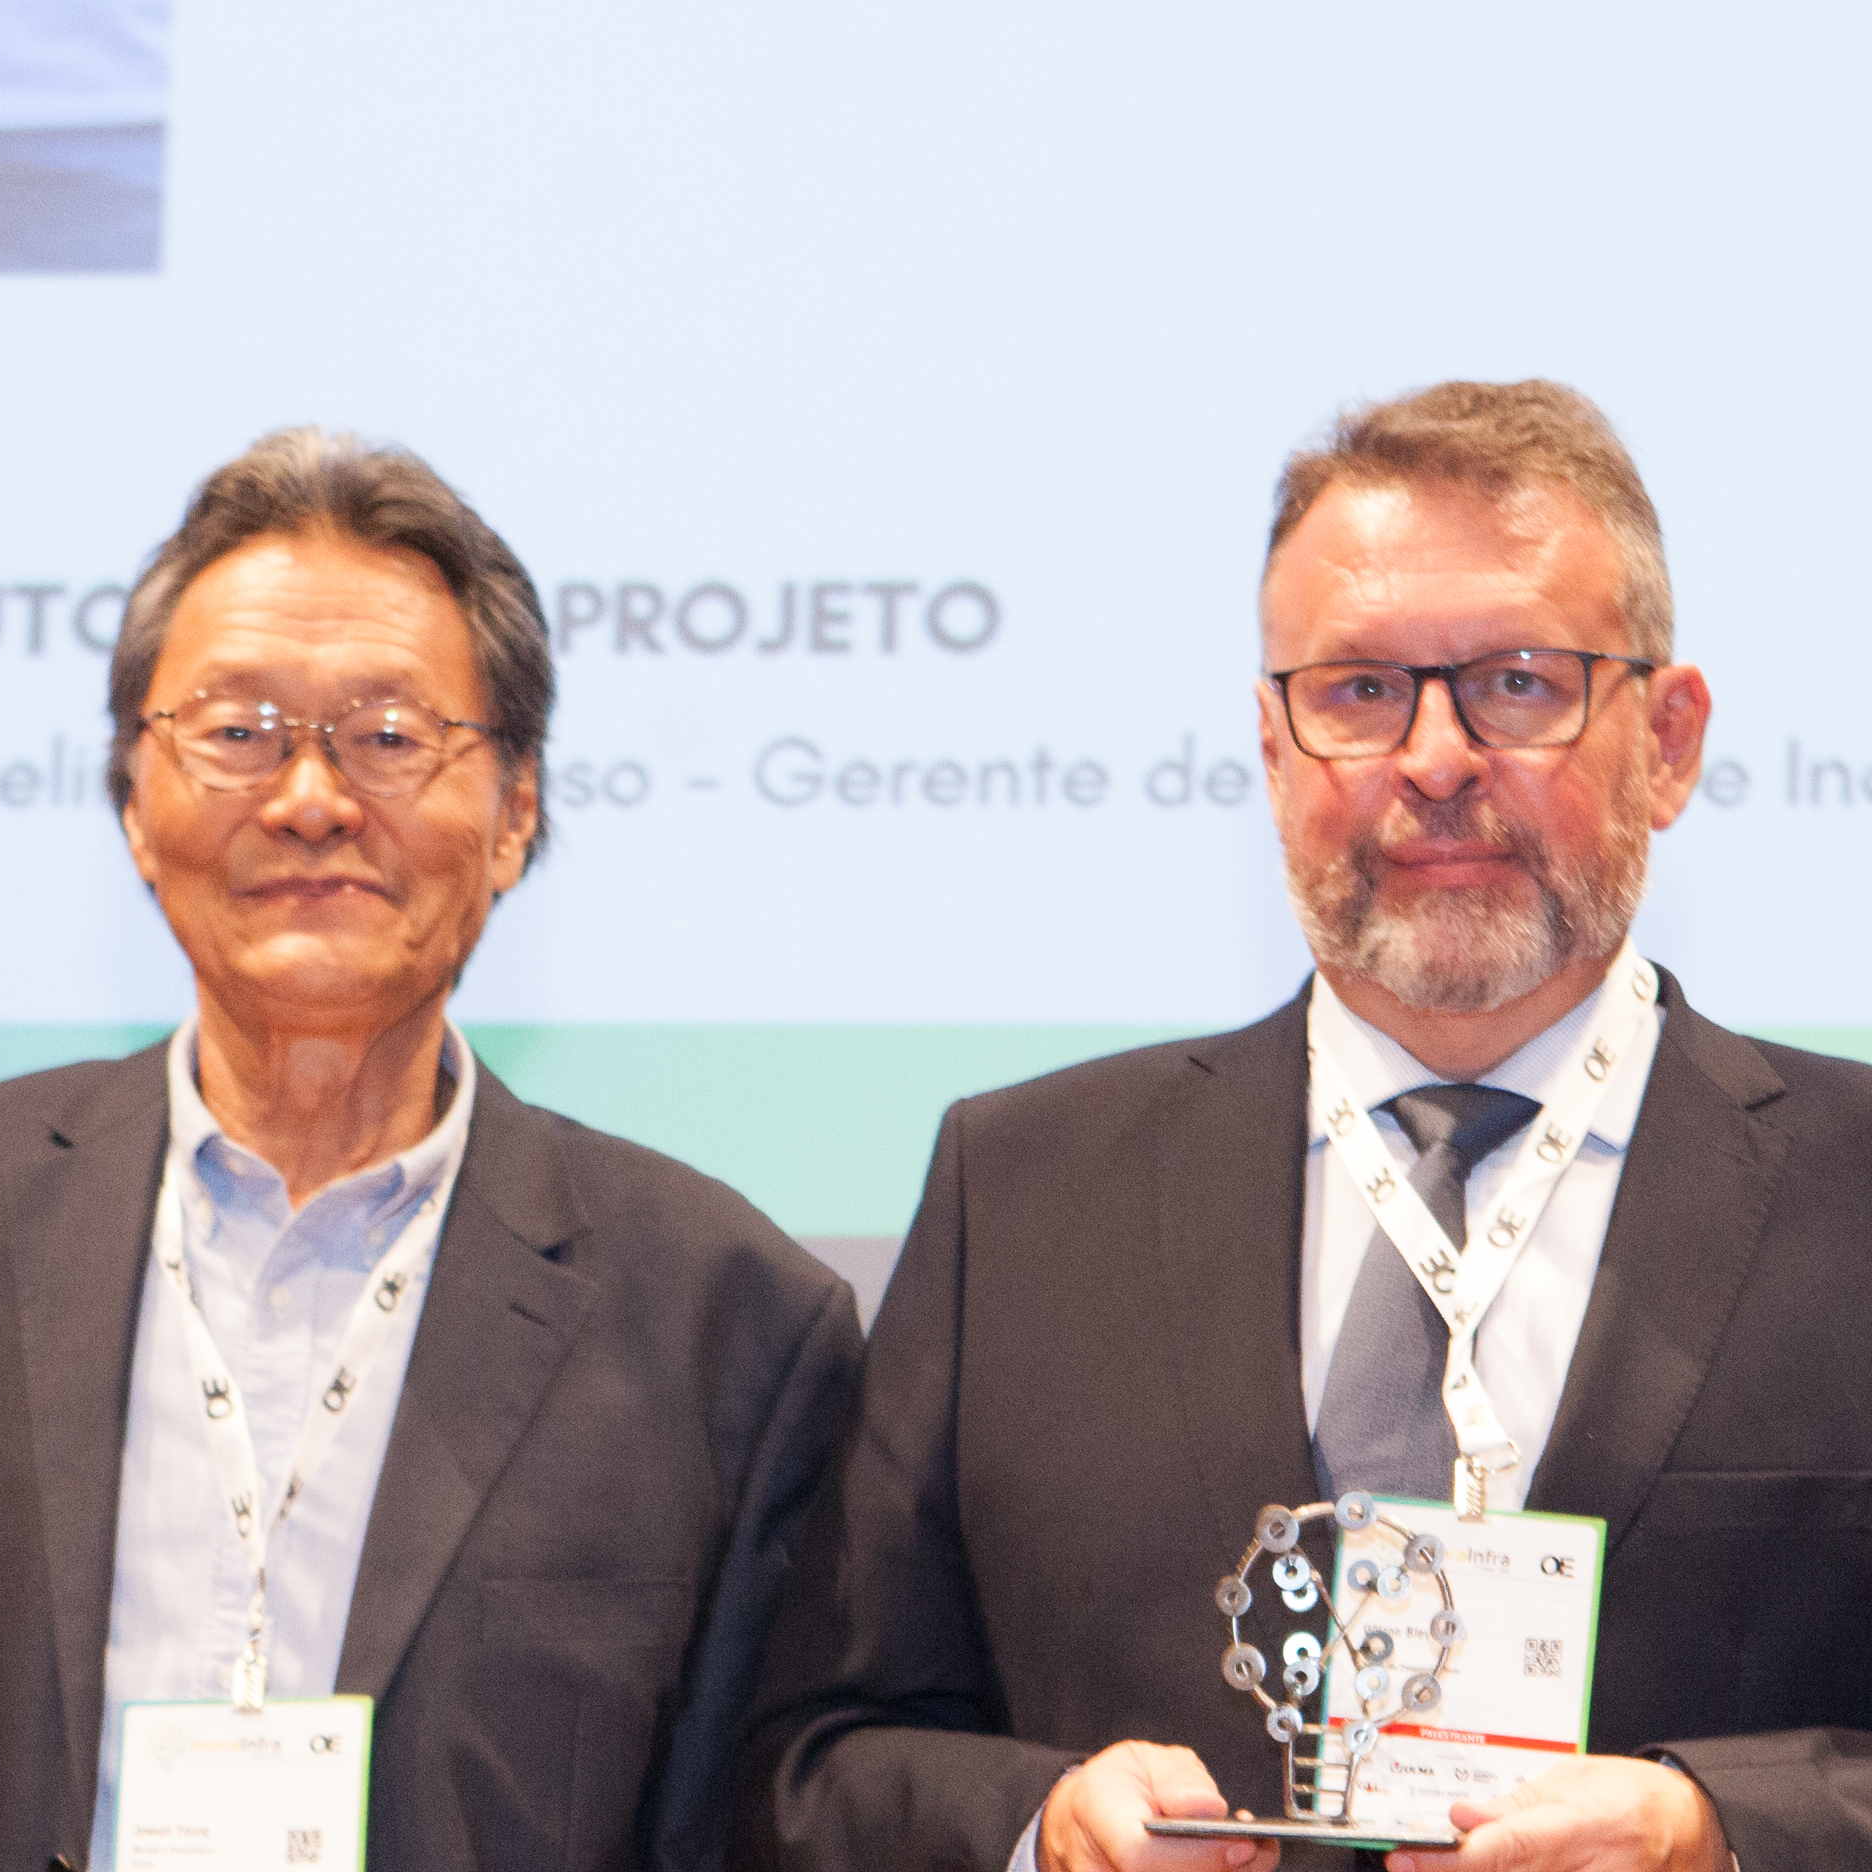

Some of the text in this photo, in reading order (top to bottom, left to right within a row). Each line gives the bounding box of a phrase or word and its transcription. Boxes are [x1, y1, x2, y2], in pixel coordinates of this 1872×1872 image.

[556, 580, 1002, 656] PROJETO
[549, 758, 652, 809] so
[753, 734, 1112, 809] Gerente
[1144, 729, 1255, 809] de
